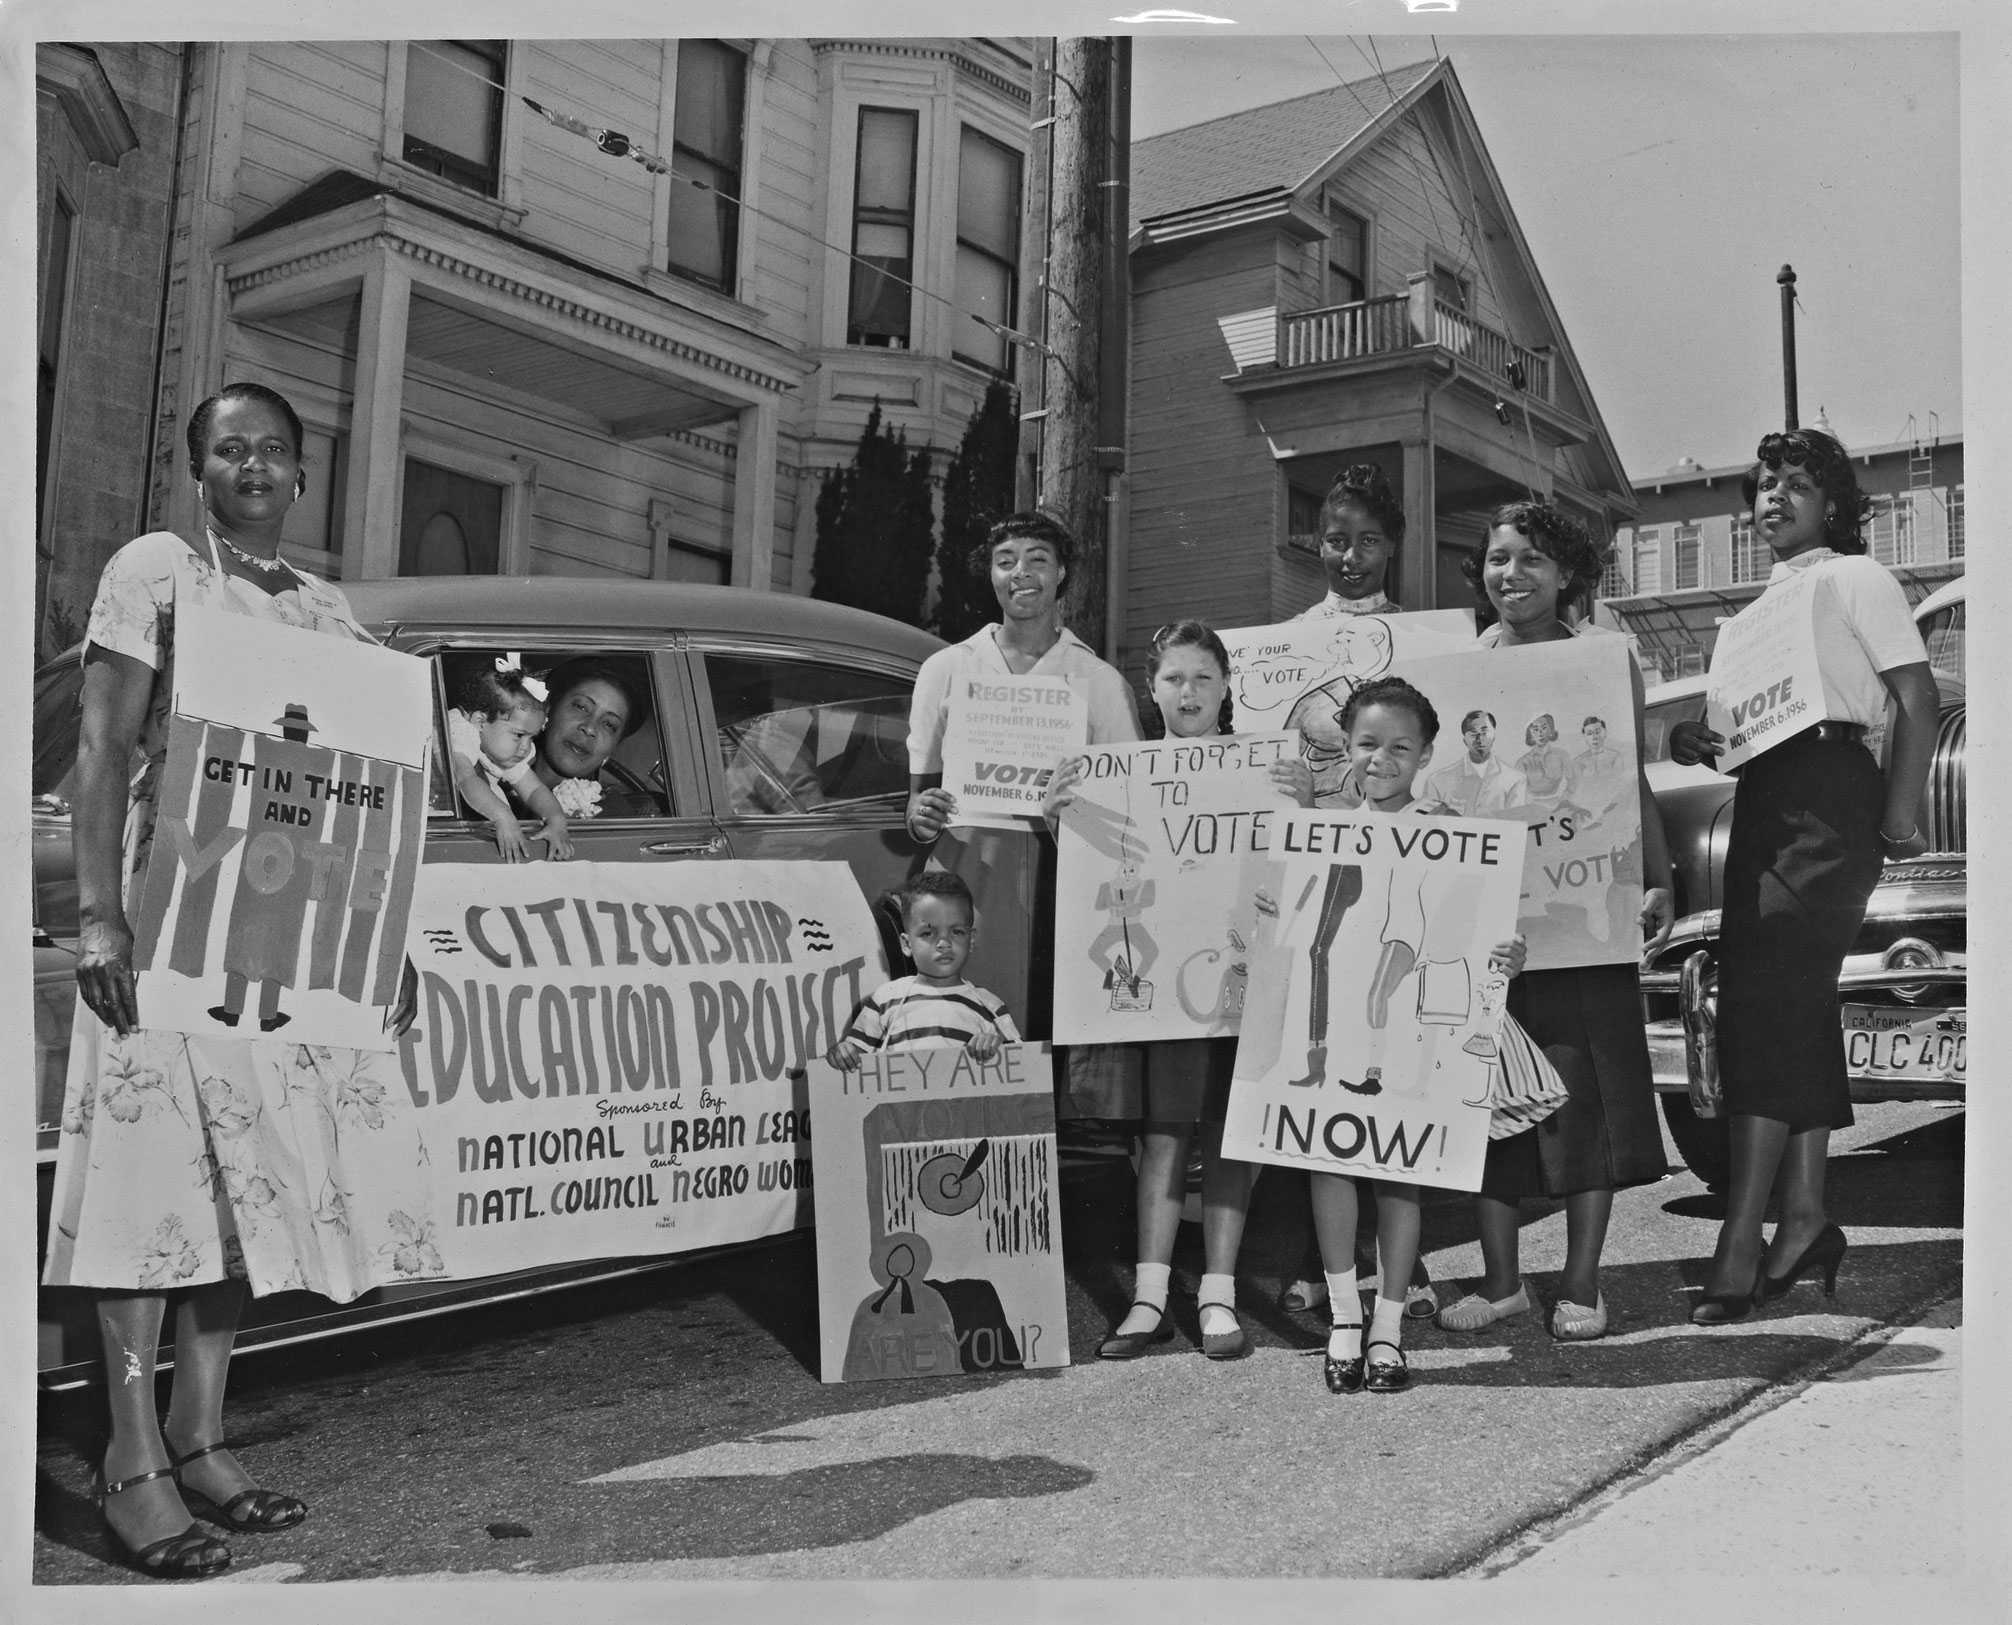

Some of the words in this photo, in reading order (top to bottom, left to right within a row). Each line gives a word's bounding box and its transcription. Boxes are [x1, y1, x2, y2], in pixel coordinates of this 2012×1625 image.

[1258, 643, 1292, 656] YOUR
[968, 682, 1072, 706] REGISTER
[1263, 667, 1308, 684] VOTE
[1731, 675, 1794, 728] VOTE
[1729, 715, 1776, 750] NOVEMBER
[974, 761, 1055, 788] VOTE
[1075, 748, 1162, 779] DON'T
[1173, 739, 1289, 773] FORGET
[204, 757, 256, 787] GET
[263, 767, 293, 794] IN
[304, 773, 386, 811] THERE
[963, 783, 1023, 801] NOVEMBER
[1151, 780, 1190, 808] TO
[264, 801, 313, 828] AND
[1162, 810, 1275, 857] VOTE
[1284, 821, 1374, 856] LET'S
[1390, 825, 1501, 865] VOTE
[161, 814, 393, 912] VOTE
[464, 898, 793, 969] CITIZENSHIP
[399, 970, 681, 1108] EDUCATION
[1852, 1016, 1913, 1030] CALIFORNIA
[949, 1045, 1026, 1088] ARE
[1848, 1031, 1911, 1070] CLC
[595, 1091, 684, 1121] Sponsored
[699, 1088, 727, 1111] By
[456, 1125, 625, 1173] NATIONAL
[642, 1114, 746, 1156] URBAN
[650, 1153, 683, 1169] and
[550, 1173, 659, 1216] COUNCIL
[672, 1164, 750, 1203] NEGRO
[947, 1323, 1043, 1373] YOU?
